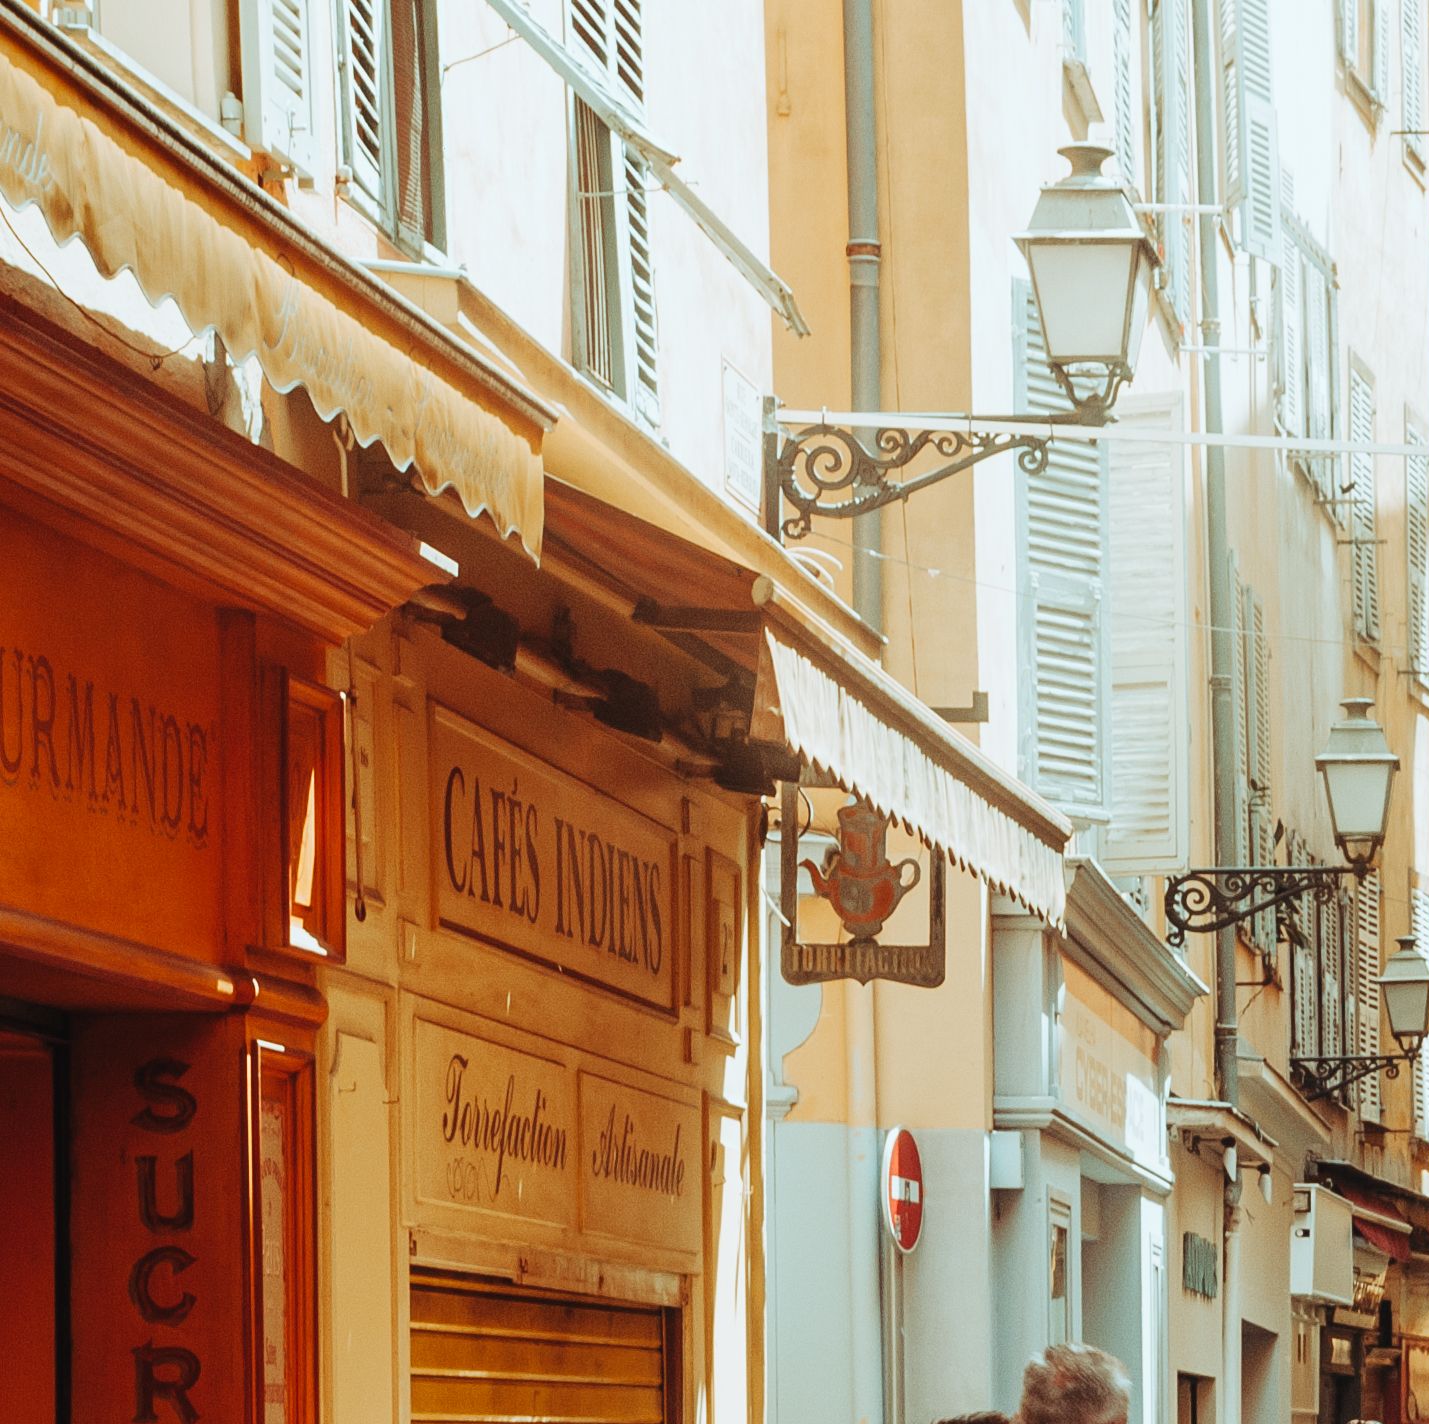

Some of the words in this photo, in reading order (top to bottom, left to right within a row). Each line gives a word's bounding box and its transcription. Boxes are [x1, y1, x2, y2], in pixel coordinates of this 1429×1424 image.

[444, 767, 540, 923] CAFÉS
[554, 816, 662, 976] INDIENS
[592, 1103, 685, 1197] Artisanale
